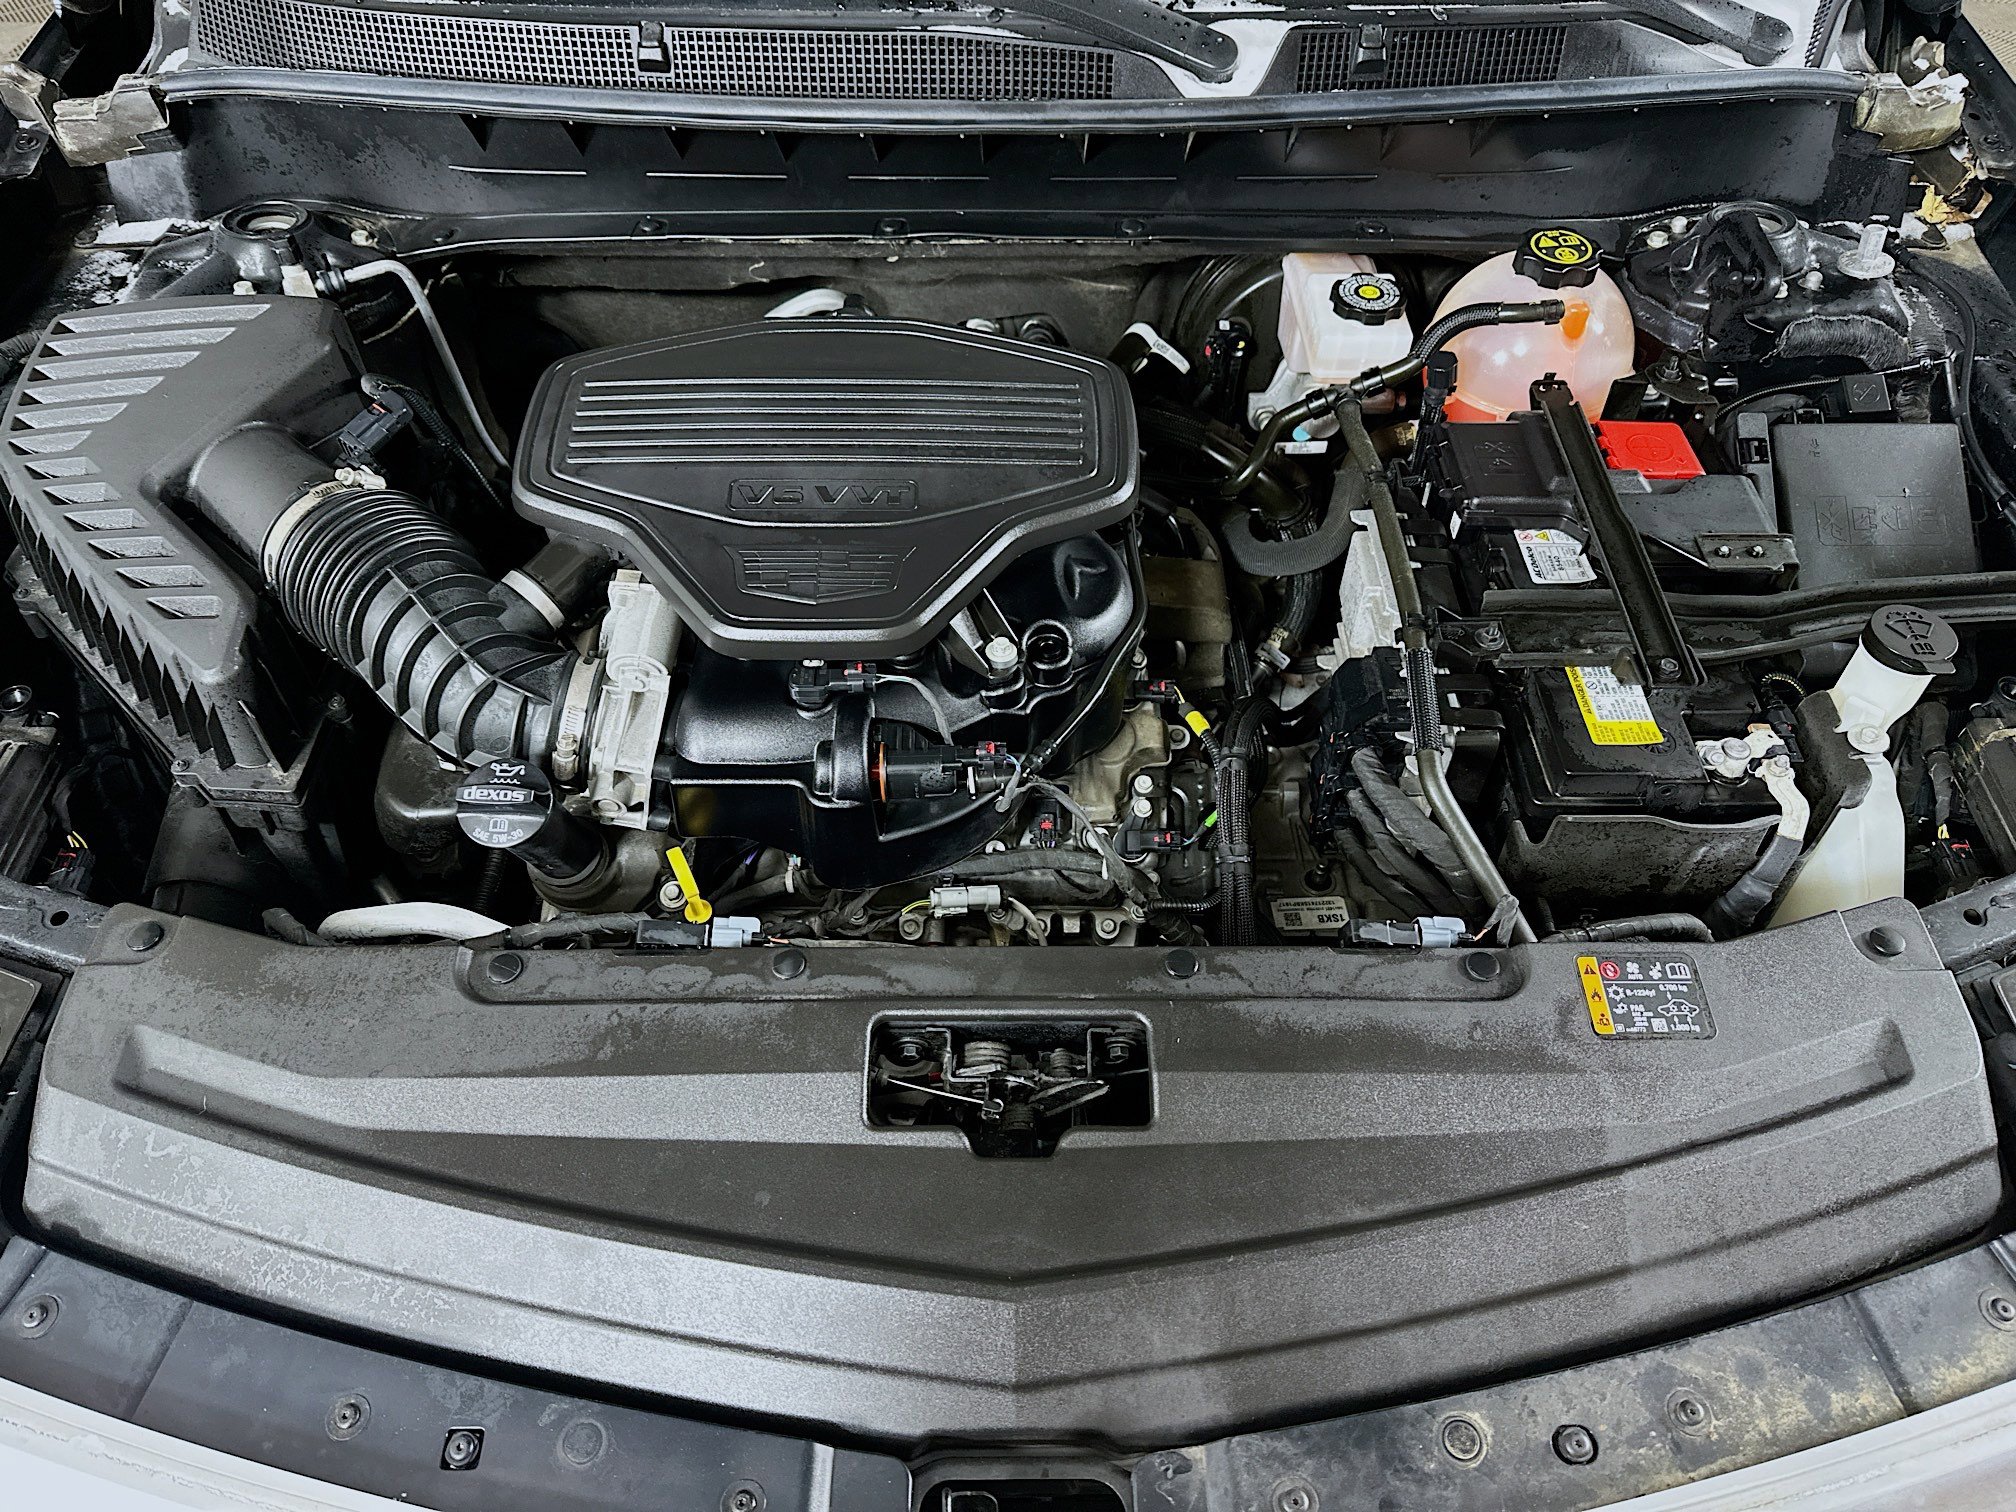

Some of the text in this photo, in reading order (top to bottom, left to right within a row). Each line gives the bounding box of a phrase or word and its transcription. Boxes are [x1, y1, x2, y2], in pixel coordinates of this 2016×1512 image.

[737, 485, 911, 505] V6 VVT
[463, 786, 528, 802] dexos
[473, 828, 524, 843] SAE 5W-30
[1317, 914, 1346, 923] 1SKB
[1625, 989, 1656, 998] R-1234yf
